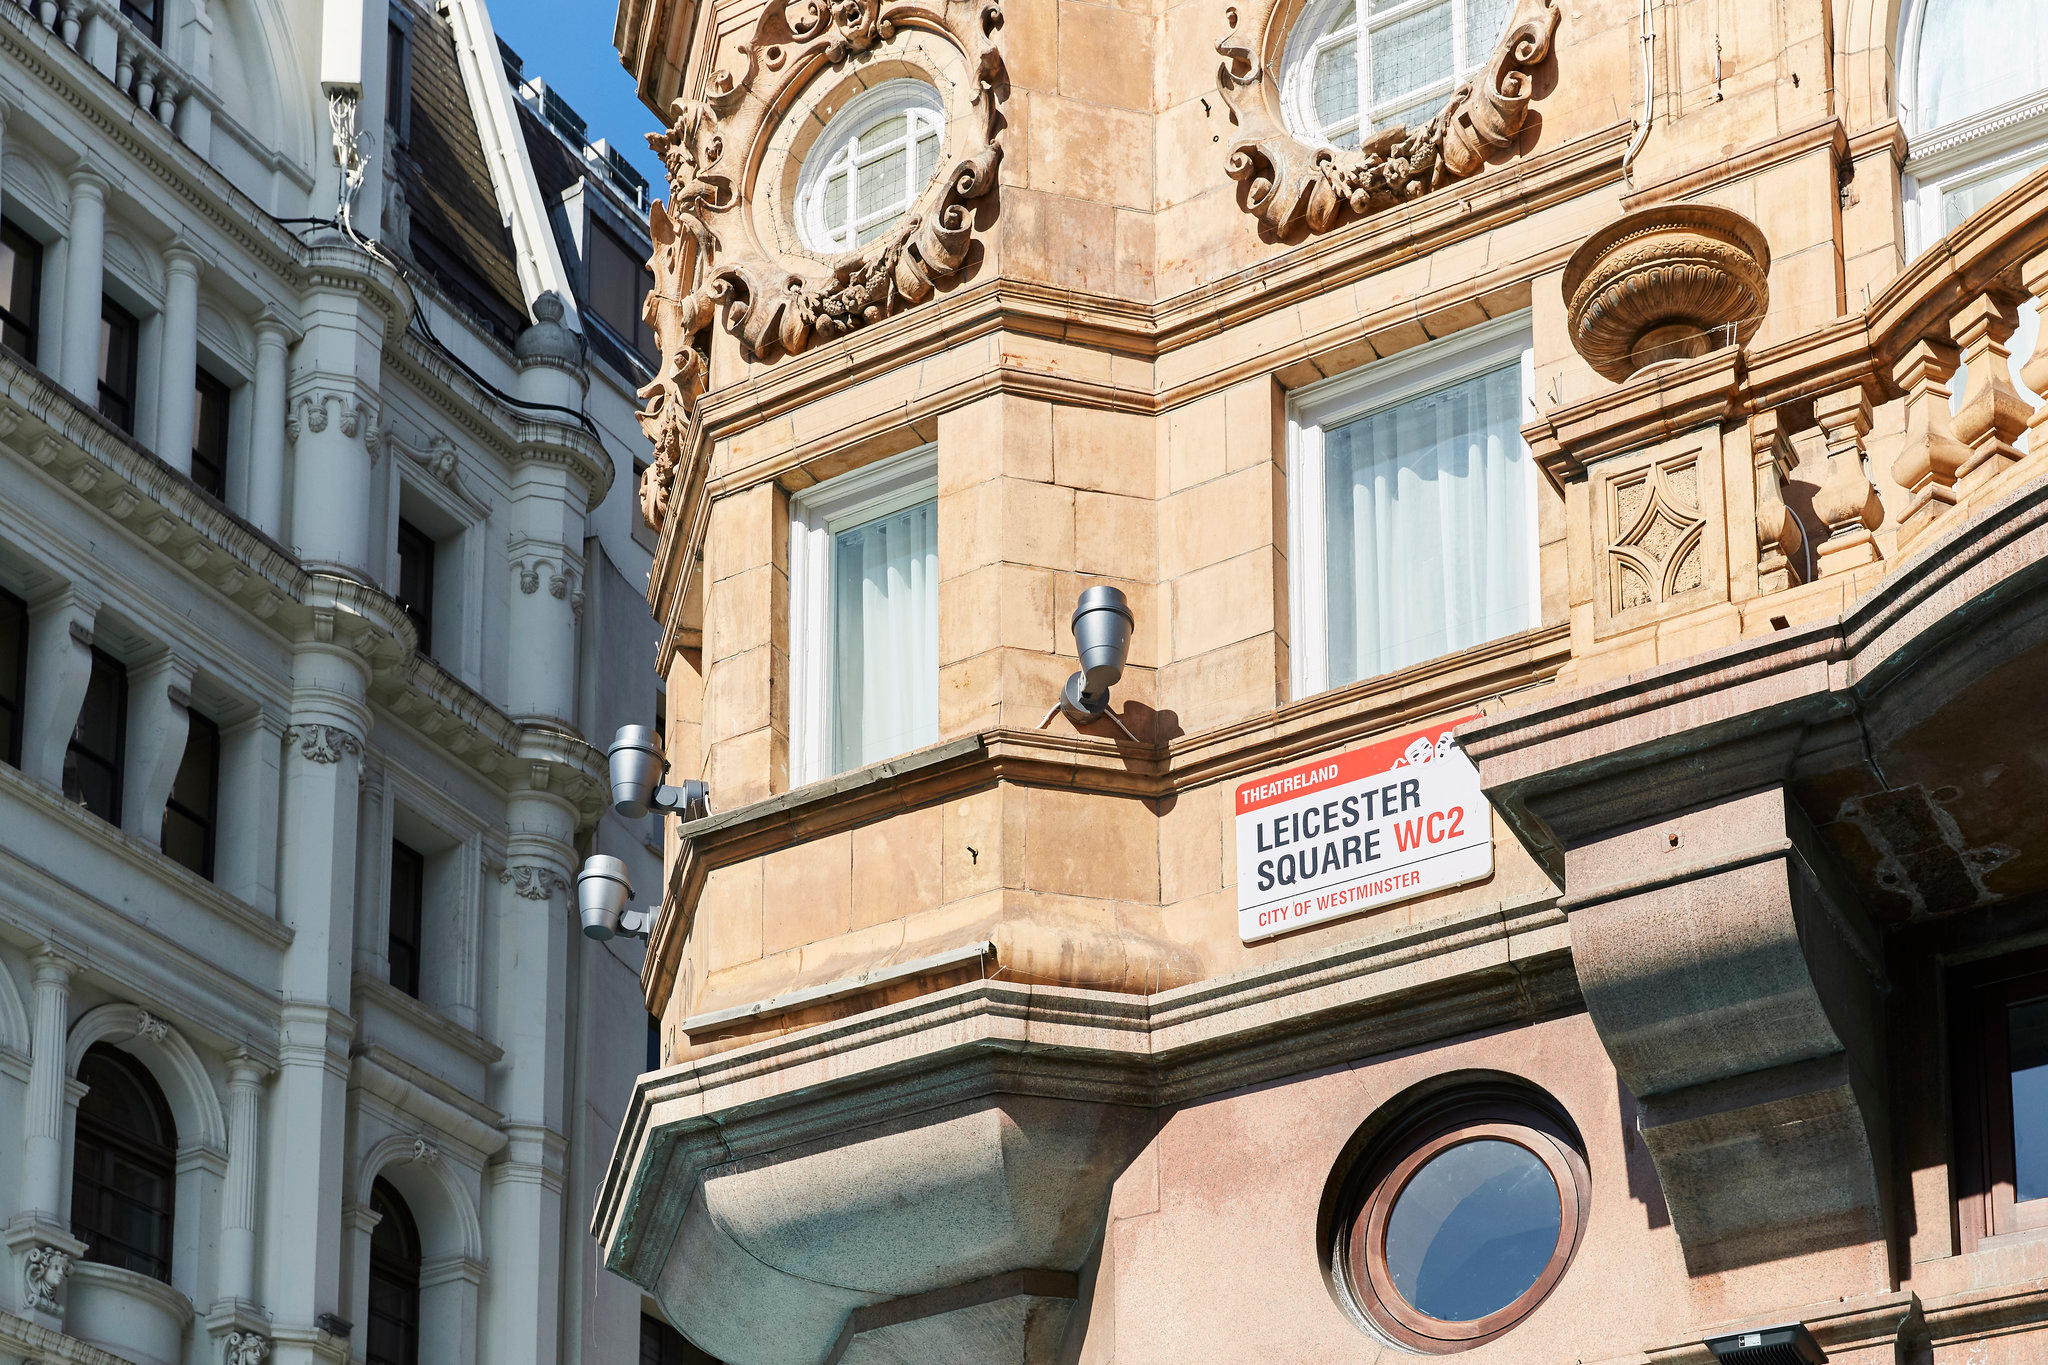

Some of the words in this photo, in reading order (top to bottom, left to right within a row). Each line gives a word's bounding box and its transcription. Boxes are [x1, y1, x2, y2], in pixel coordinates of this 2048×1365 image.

[1242, 764, 1338, 805] THEATRELAND
[1257, 778, 1421, 853] LEICESTER
[1257, 829, 1381, 892] SQUARE
[1394, 806, 1465, 853] WC2
[1258, 906, 1289, 927] CITY
[1294, 900, 1312, 917] OF
[1317, 870, 1420, 911] WESTMINSTER
